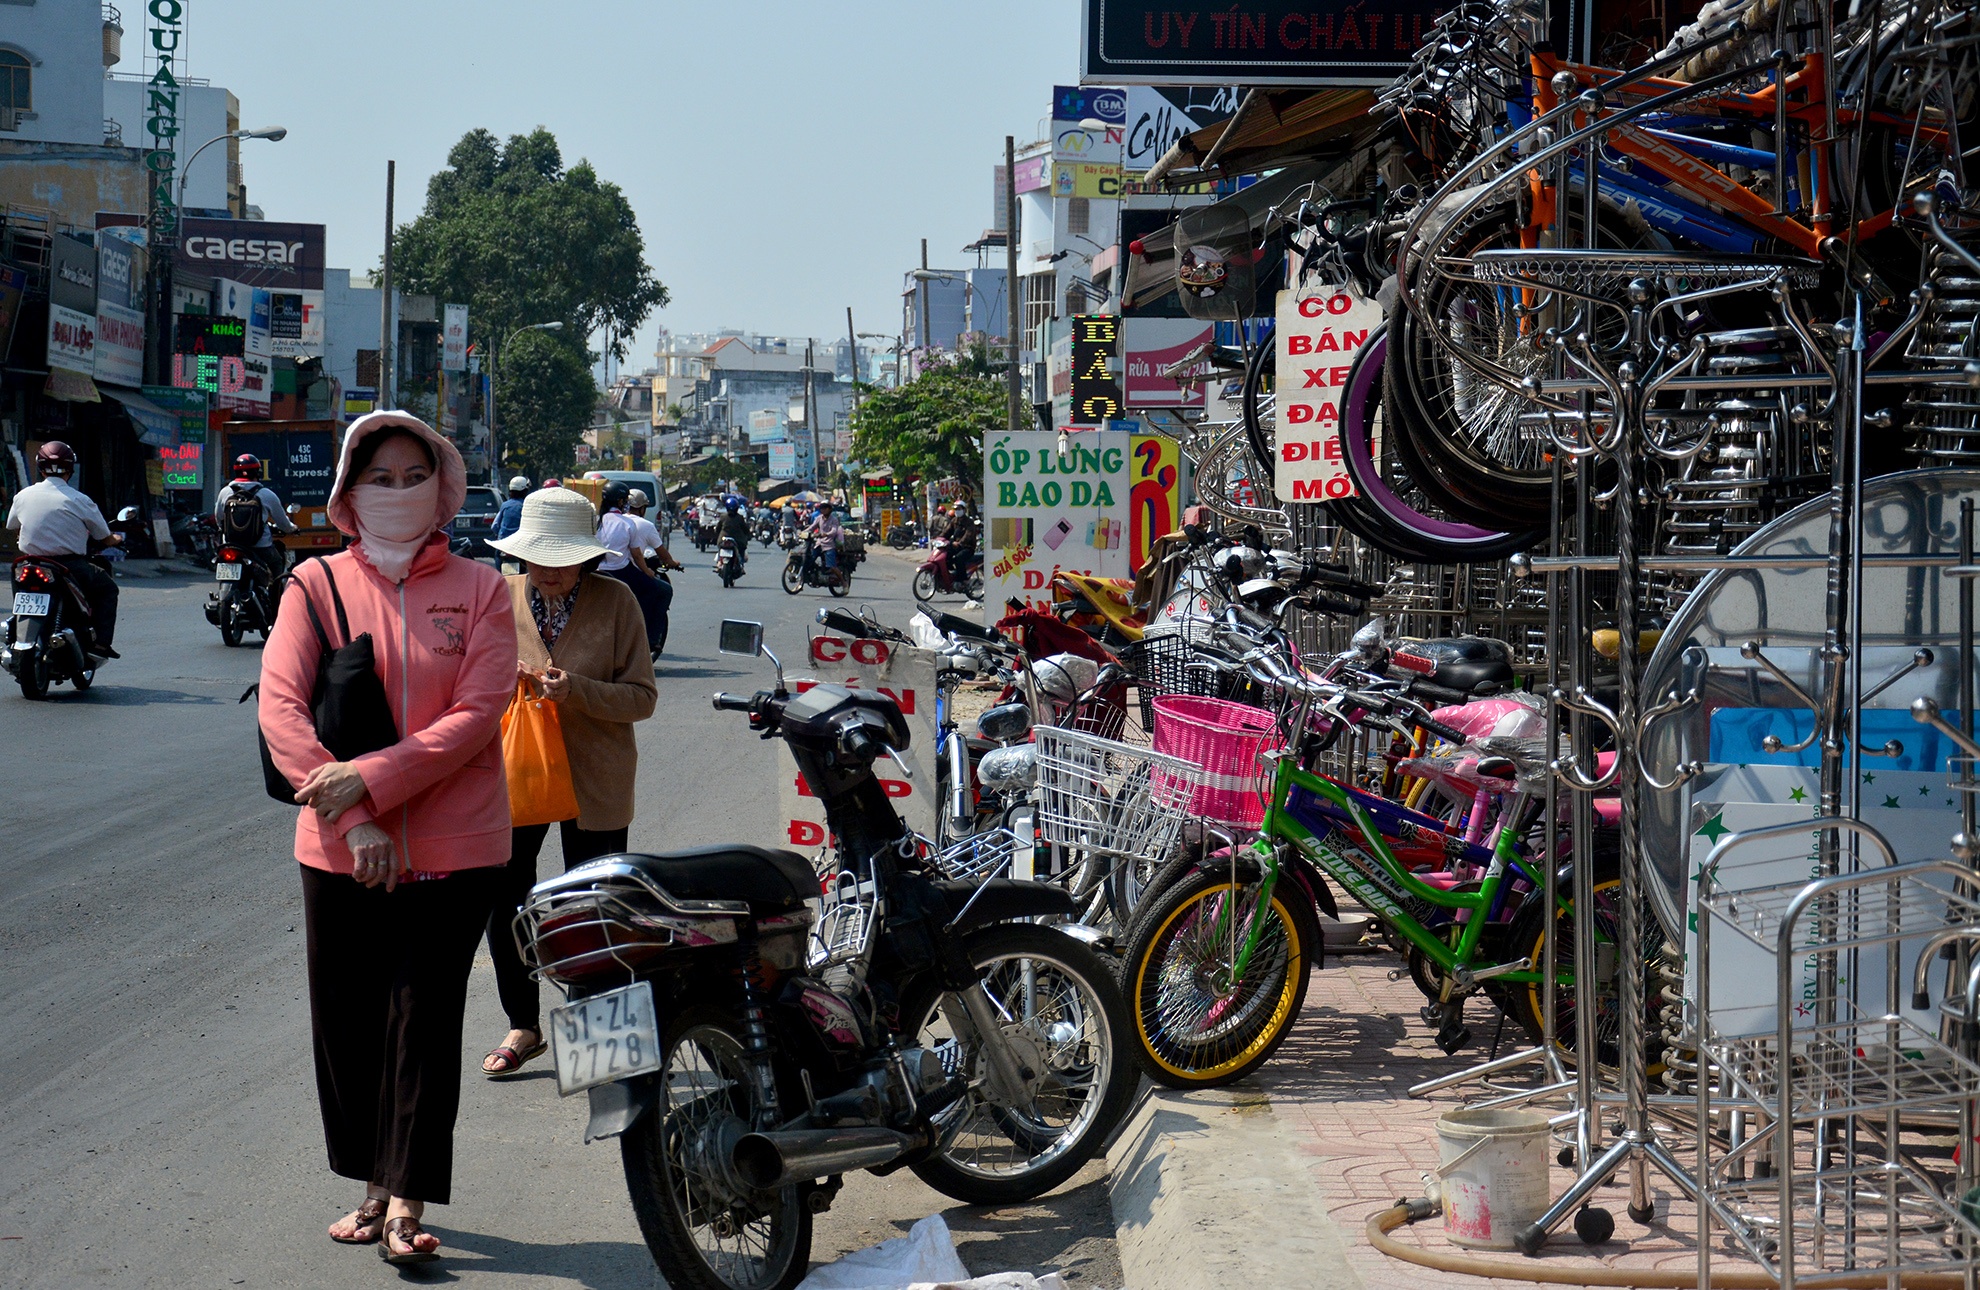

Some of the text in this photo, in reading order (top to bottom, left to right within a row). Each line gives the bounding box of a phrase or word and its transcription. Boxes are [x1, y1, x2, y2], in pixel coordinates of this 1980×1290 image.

[1144, 11, 1199, 50] UY
[1210, 3, 1267, 50] TÍN
[1278, 0, 1384, 51] CHẤT
[185, 236, 305, 265] caesar
[101, 247, 131, 284] caesar
[1298, 289, 1353, 318] CÓ
[213, 321, 243, 337] KHẮC
[1288, 326, 1368, 356] BÁN
[173, 353, 246, 393] LED
[1128, 357, 1150, 377] RỬA
[1287, 402, 1338, 428] ĐẠ
[298, 444, 311, 453] 43C
[989, 436, 1031, 475] ỐP
[167, 472, 197, 485] Card
[998, 481, 1116, 507] BAO DA
[993, 556, 1013, 578] GIÁ
[1302, 836, 1403, 917] ACTIVE BIKE
[567, 1031, 643, 1087] 2728
